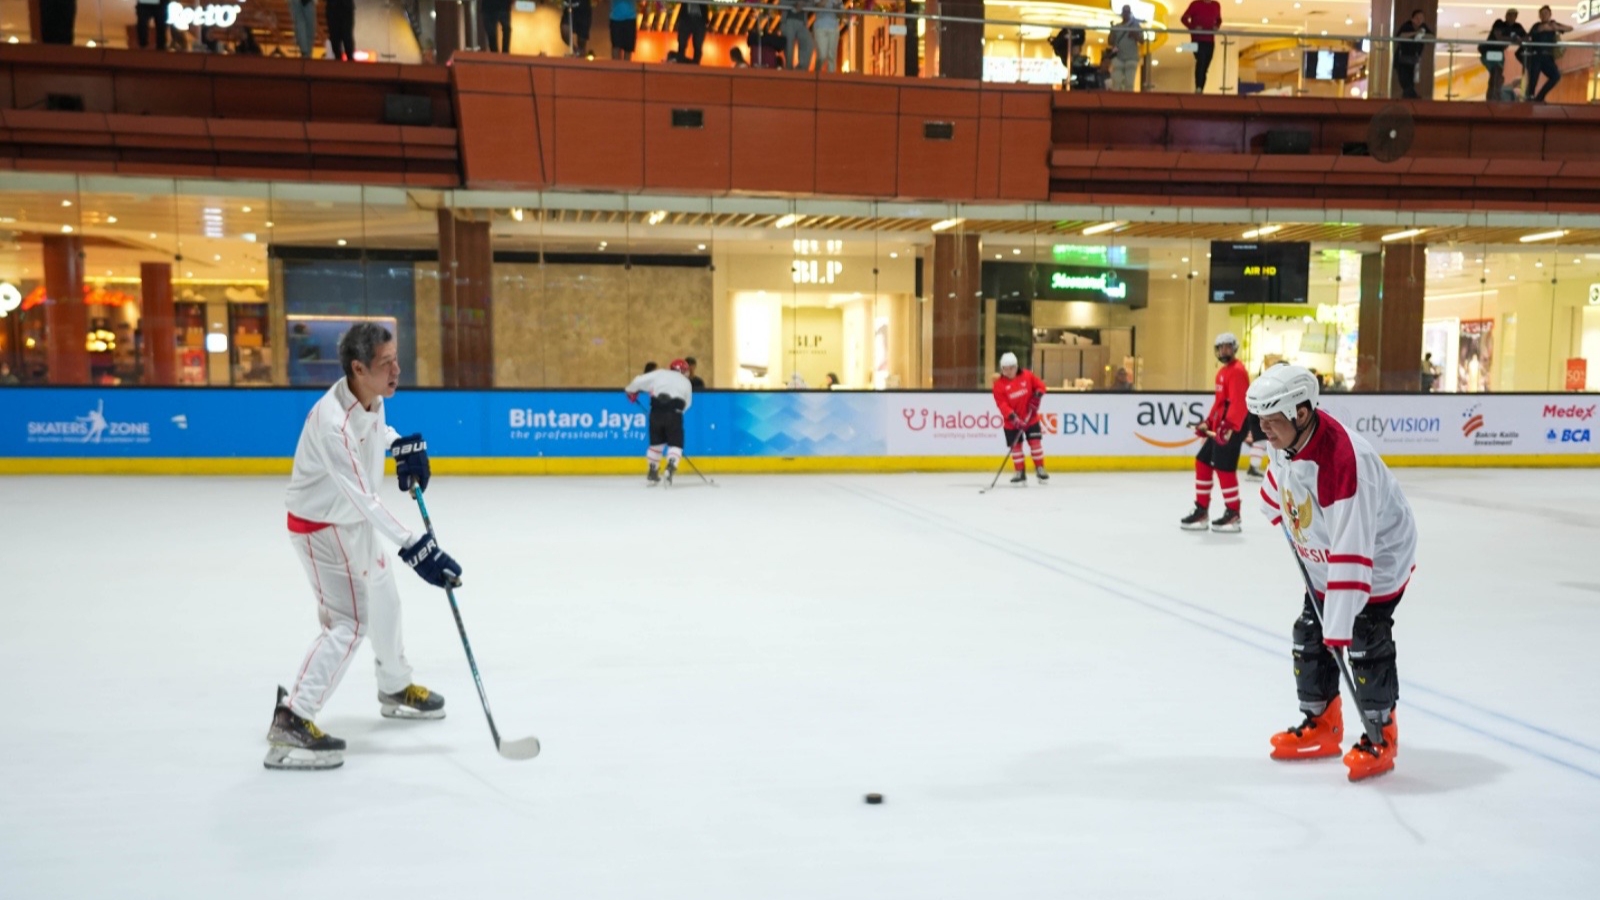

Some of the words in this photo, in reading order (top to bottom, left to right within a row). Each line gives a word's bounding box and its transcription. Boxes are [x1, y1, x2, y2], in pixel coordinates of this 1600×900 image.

[793, 260, 843, 284] BLP
[1244, 266, 1260, 275] AIR
[509, 408, 593, 428] Bintaro
[598, 409, 647, 431] Jaya
[933, 411, 1004, 429] halodo
[1136, 401, 1205, 427] aws
[1542, 404, 1596, 421] Medex
[27, 421, 88, 434] SKATERS
[109, 422, 150, 435] ZONE
[1063, 413, 1109, 435] BNI
[1355, 415, 1441, 438] cityvision
[510, 430, 530, 439] the
[534, 429, 619, 440] professional's
[623, 430, 646, 440] city
[1561, 429, 1591, 442] BCA
